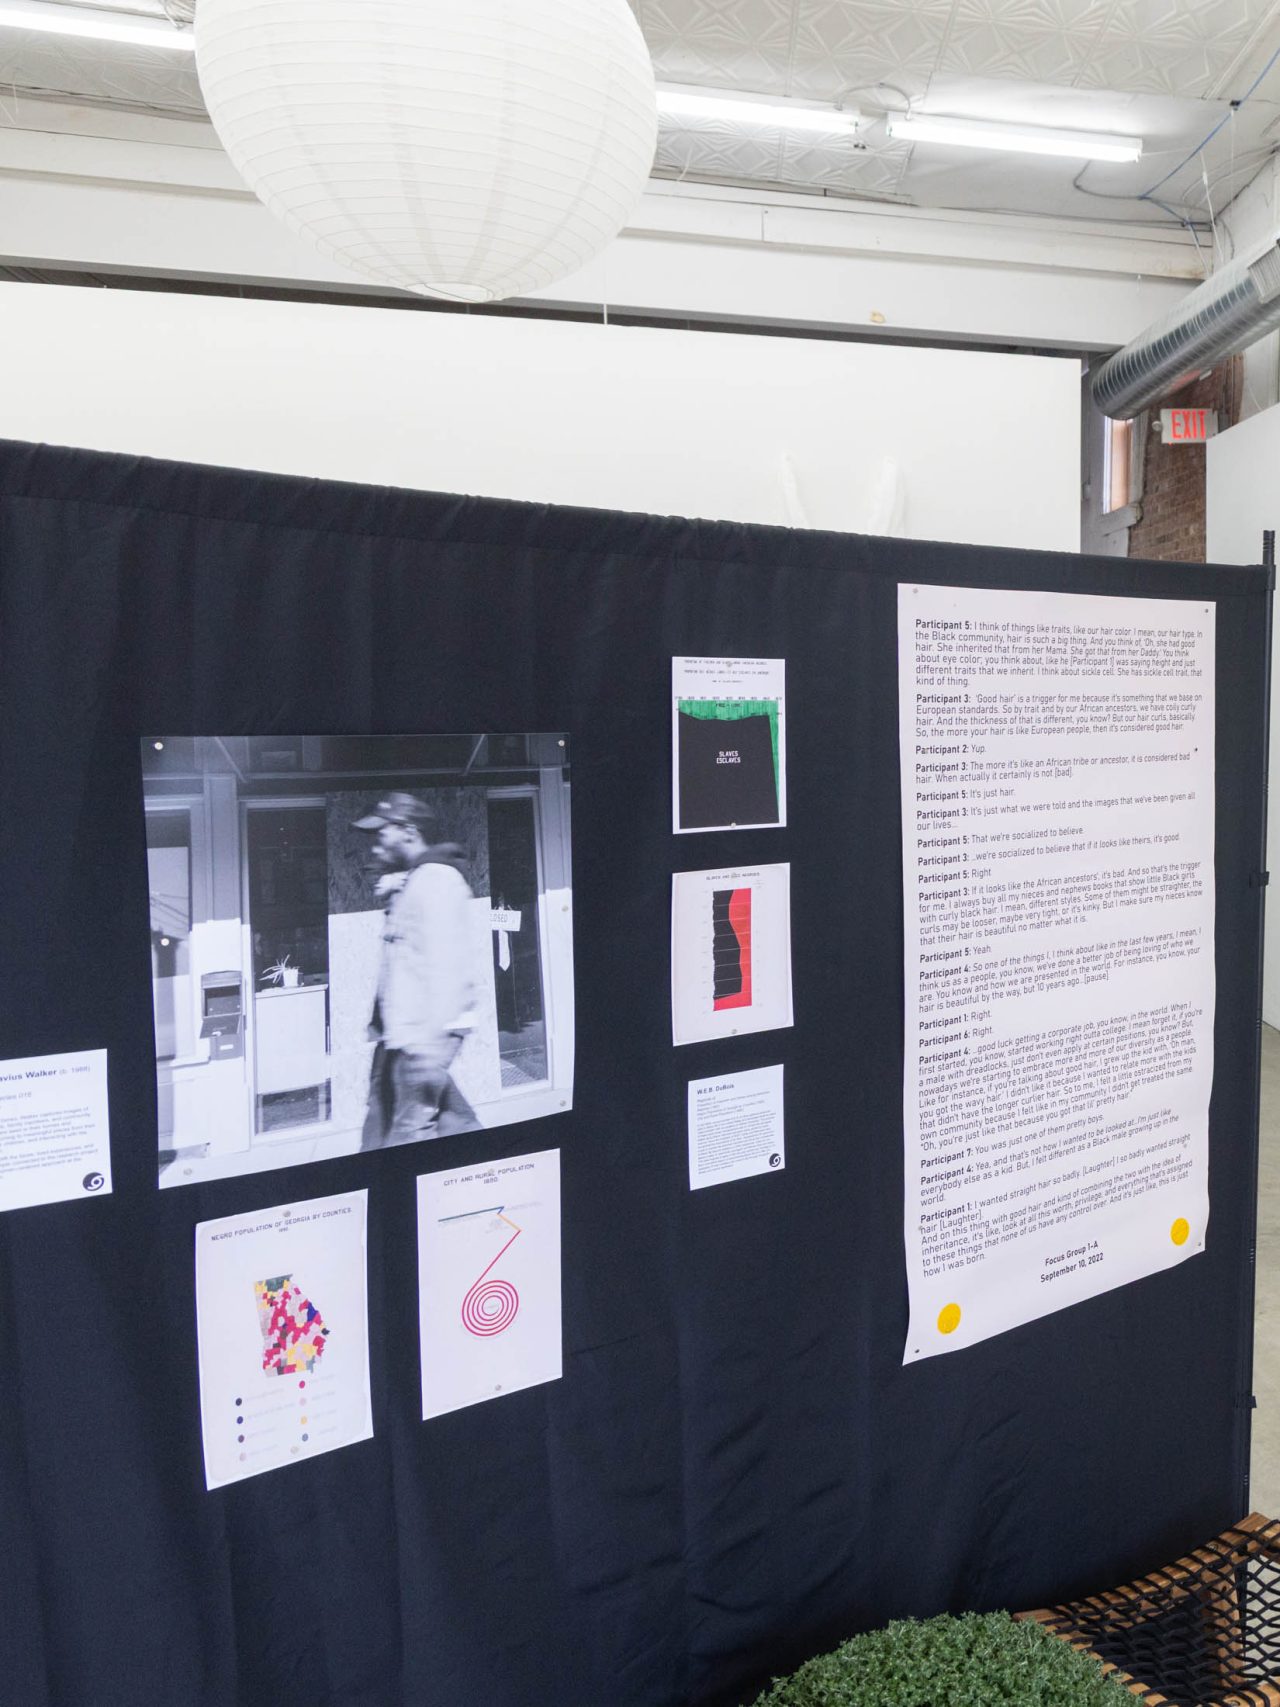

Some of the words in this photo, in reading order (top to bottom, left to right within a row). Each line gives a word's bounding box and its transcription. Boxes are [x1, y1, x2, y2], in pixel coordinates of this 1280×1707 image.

[1171, 409, 1207, 440] EXIT
[915, 618, 962, 631] Participant
[964, 620, 972, 630] 5:
[979, 621, 999, 630] think
[1001, 622, 1009, 631] of
[1011, 622, 1035, 634] things
[1036, 623, 1049, 633] like
[1073, 625, 1085, 634] like
[1100, 626, 1113, 635] hair
[1168, 628, 1181, 637] hair
[915, 675, 934, 685] kind
[936, 675, 945, 685] of
[916, 693, 961, 705] Participant
[963, 693, 971, 703] 3:
[1017, 695, 1023, 703] is
[1031, 694, 1056, 704] trigger
[1057, 693, 1068, 702] for
[1081, 693, 1109, 702] because
[1111, 693, 1120, 702] it's
[1121, 693, 1154, 704] something
[1155, 693, 1167, 701] that
[1178, 693, 1193, 701] base
[915, 744, 959, 756] Participant
[961, 743, 969, 753] 2:
[934, 772, 957, 782] When
[959, 771, 990, 782] actually
[991, 770, 996, 780] it
[998, 769, 1031, 780] certainly
[1033, 769, 1039, 777] is
[1041, 769, 1052, 777] not
[916, 790, 959, 802] Participant
[961, 789, 968, 799] 5:
[969, 788, 981, 798] It's
[983, 788, 997, 799] just
[916, 808, 959, 819] Participant
[961, 807, 968, 816] 3:
[970, 806, 982, 815] It's
[983, 805, 998, 816] just
[999, 804, 1018, 813] what
[1019, 804, 1030, 812] we
[1052, 800, 1066, 809] told
[1067, 799, 1080, 808] and
[1081, 799, 1093, 807] the
[1094, 798, 1118, 807] images
[1119, 796, 1132, 804] that
[1134, 795, 1151, 803] we've
[1152, 794, 1168, 802] been
[1169, 793, 1186, 803] given
[1187, 791, 1195, 799] all
[916, 822, 931, 830] our
[917, 836, 960, 848] Participant
[962, 835, 969, 844] 5:
[971, 834, 987, 843] That
[989, 832, 1010, 841] we're
[1011, 828, 1048, 840] socialized
[918, 871, 960, 884] Participant
[962, 869, 969, 879] 5:
[919, 935, 935, 945] that
[937, 932, 956, 943] their
[958, 930, 973, 940] hair
[975, 928, 982, 937] is
[984, 923, 1016, 936] beautiful
[1029, 920, 1053, 929] matter
[1054, 916, 1071, 925] what
[1073, 915, 1078, 923] it
[919, 948, 962, 963] Participant
[964, 946, 971, 956] 5:
[918, 1015, 961, 1030] Participant
[963, 1013, 968, 1022] 1:
[918, 1032, 961, 1047] Participant
[963, 1028, 970, 1039] 6:
[25, 1069, 57, 1079] Walker
[920, 1150, 964, 1168] Participant
[966, 1147, 973, 1156] 7:
[975, 1145, 989, 1154] You
[990, 1140, 1006, 1150] was
[1008, 1135, 1022, 1148] just
[1024, 1132, 1037, 1142] one
[1038, 1127, 1045, 1137] of
[1047, 1125, 1065, 1135] them
[1066, 1118, 1086, 1131] pretty
[461, 1175, 473, 1183] AND
[498, 1163, 535, 1175] POPULATION
[211, 1231, 233, 1241] NEGRO
[234, 1223, 273, 1236] POPULATION
[275, 1220, 282, 1228] OF
[284, 1215, 310, 1225] GEORGIA
[312, 1213, 321, 1221] BY
[1044, 1253, 1065, 1266] Focus
[1066, 1246, 1086, 1258] Group
[1087, 1240, 1098, 1250] 1-A
[922, 1265, 940, 1277] how
[947, 1259, 964, 1269] was
[1040, 1263, 1077, 1282] September
[1078, 1258, 1086, 1268] 10,
[1087, 1252, 1103, 1264] 2022
